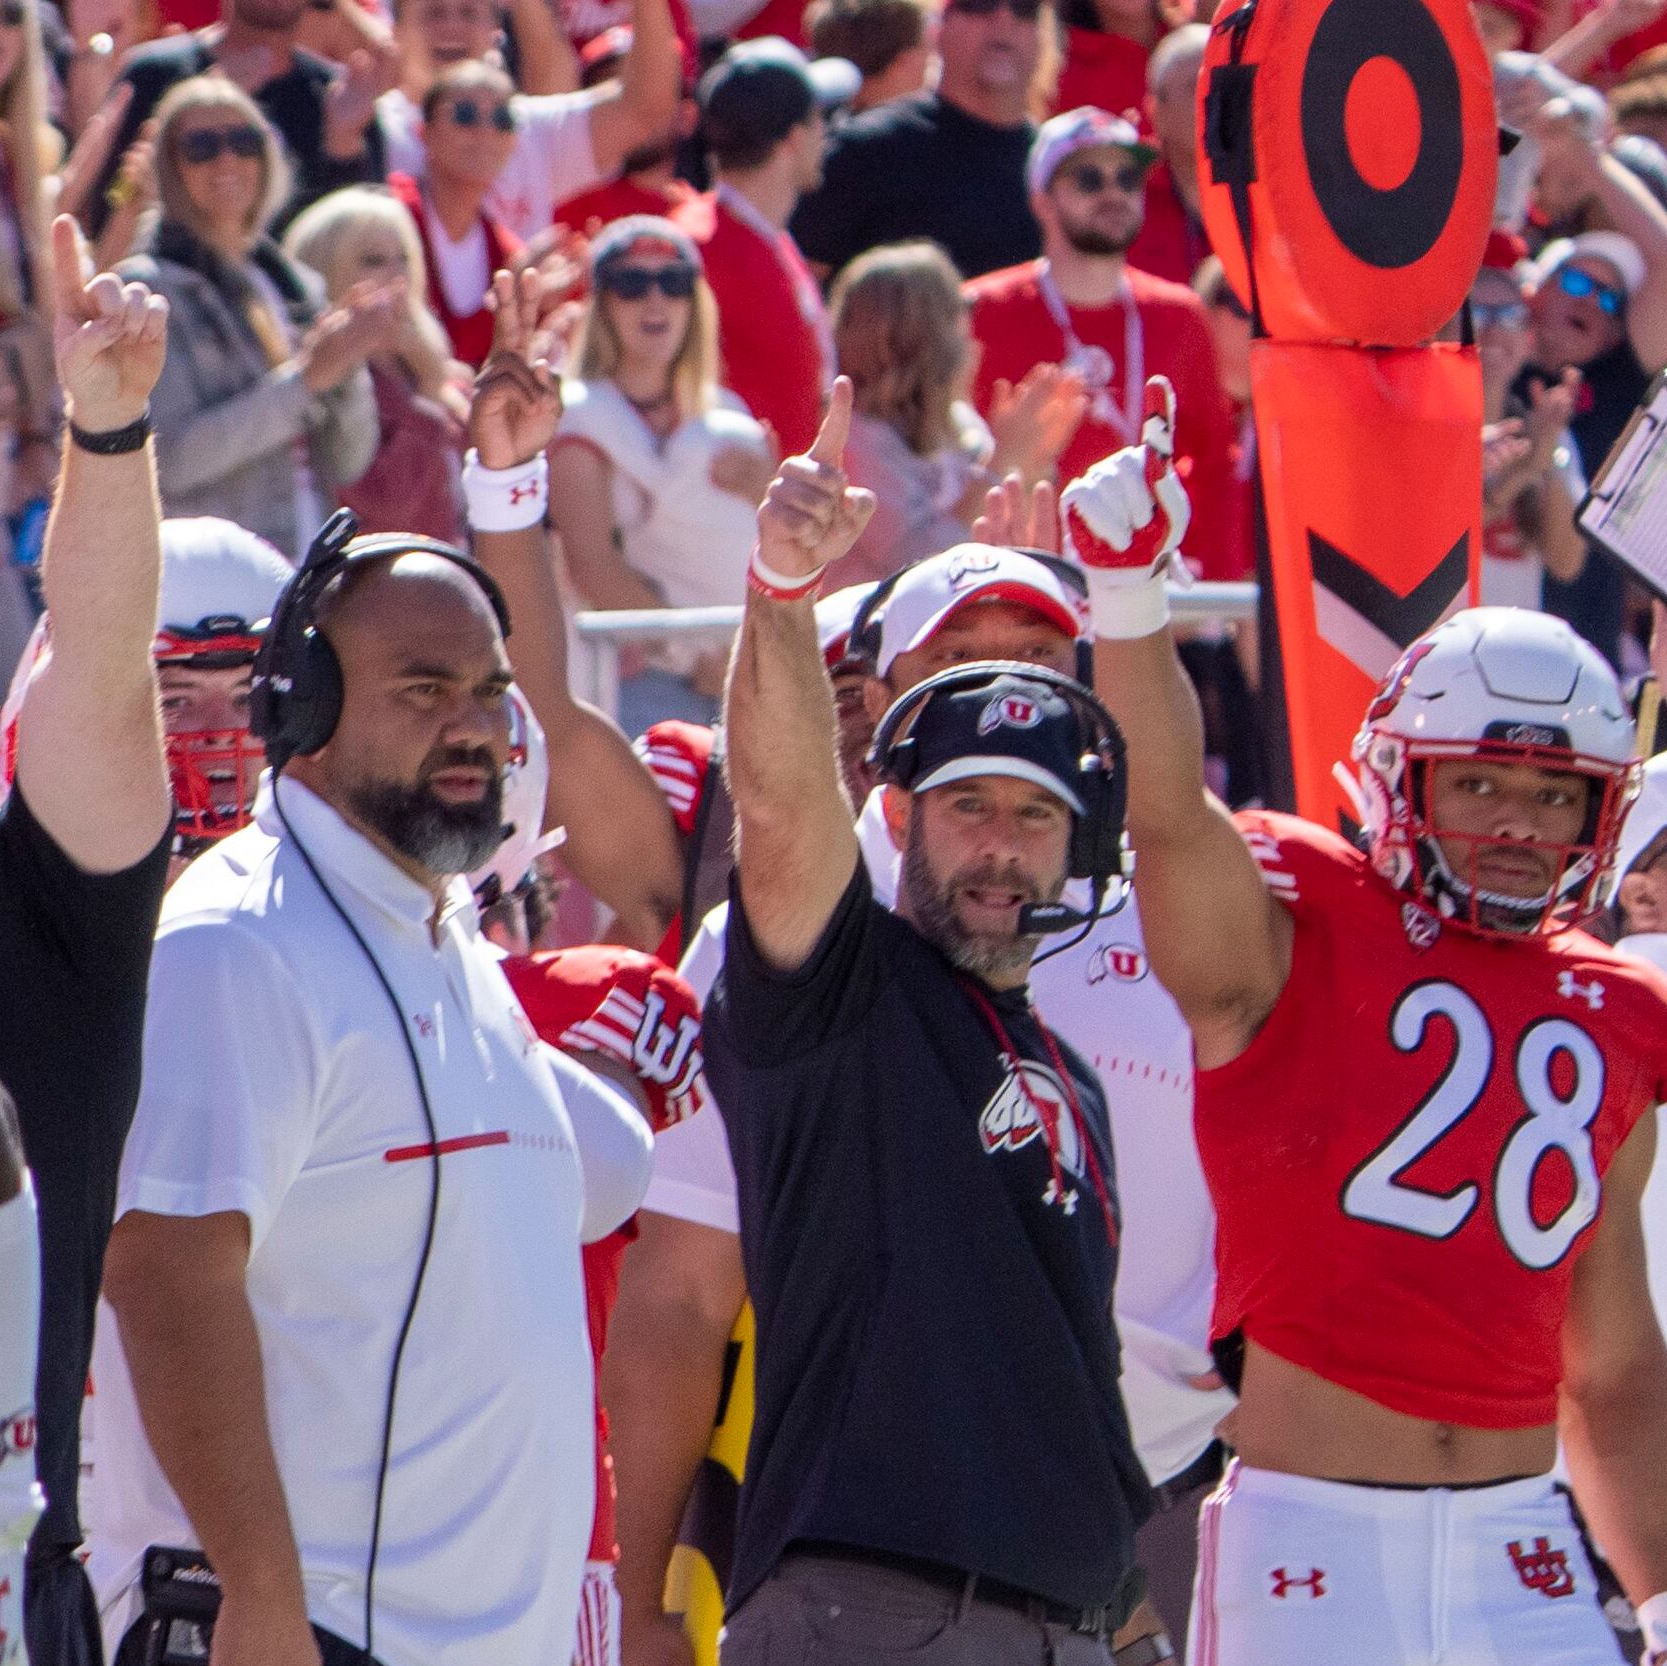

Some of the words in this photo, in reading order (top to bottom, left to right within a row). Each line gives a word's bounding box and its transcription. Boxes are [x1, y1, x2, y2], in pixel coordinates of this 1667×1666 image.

[1005, 700, 1034, 722] U
[1109, 951, 1140, 977] U
[1340, 977, 1605, 1271] 28
